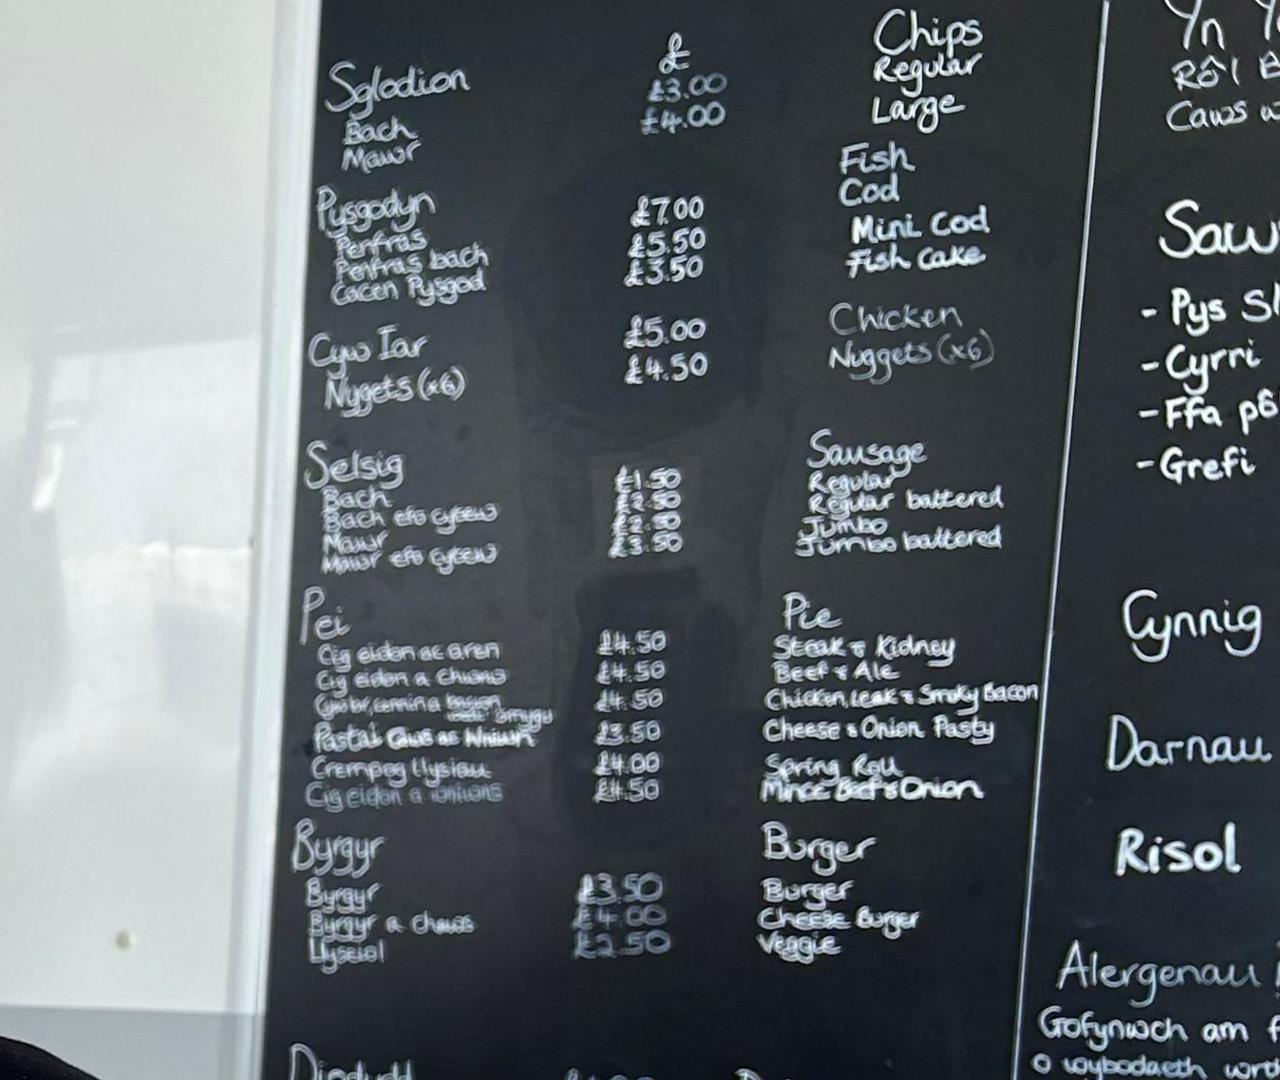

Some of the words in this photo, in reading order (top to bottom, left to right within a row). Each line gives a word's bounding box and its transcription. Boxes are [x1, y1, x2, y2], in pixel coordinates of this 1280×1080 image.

[873, 8, 983, 58] Chips
[659, 32, 690, 74] £
[325, 61, 471, 119] Sglodion
[648, 72, 728, 103] £3.00
[872, 52, 983, 97] Regular
[639, 101, 727, 135] £4.00
[871, 93, 966, 133] Large
[1166, 100, 1248, 132] Caws
[342, 117, 419, 147] Bach
[341, 140, 421, 174] Mawr
[840, 141, 916, 175] Fish
[840, 173, 901, 207] Cod
[315, 186, 436, 240] Pysgodyn
[851, 213, 922, 244] Mini
[929, 205, 991, 236] Cod
[335, 228, 429, 264] Penfras
[428, 241, 489, 271] bach
[627, 227, 707, 260] £5.50
[623, 256, 705, 288] £3.50
[845, 244, 911, 279] Fish
[330, 280, 399, 306] Cacen
[407, 267, 487, 307] Pysgod
[829, 302, 963, 335] Chicken
[1171, 287, 1227, 337] Pys
[623, 315, 707, 349] £5.00
[308, 332, 372, 379] Cyw
[623, 352, 709, 386] £4.50
[828, 339, 933, 385] Nuggets
[1165, 339, 1261, 396] Cyrri
[1164, 396, 1223, 431] Ffa
[304, 440, 403, 490] Selsig
[806, 428, 928, 477] Sausage
[1160, 445, 1256, 485] Grefi
[321, 485, 392, 512] Bach
[808, 469, 896, 497] Regular
[808, 493, 894, 520] Regular
[904, 485, 1005, 510] battered
[322, 509, 386, 533] Bach
[800, 516, 888, 540] Jumbo
[321, 530, 389, 556] Mawr
[794, 535, 898, 558] Jumbo
[901, 524, 1003, 552] battered
[320, 551, 384, 575] Mawr
[299, 586, 351, 646] Pei
[782, 591, 843, 631] Pie
[1122, 588, 1263, 663] Cynnig
[316, 643, 351, 673] Cig
[446, 641, 501, 661] aren
[596, 629, 667, 656] £4.50
[772, 634, 847, 661] Steak
[875, 633, 956, 668] Kidney
[315, 669, 348, 698] Cig
[414, 671, 431, 687] a
[595, 660, 666, 685] £4.50
[771, 660, 829, 685] Beef
[852, 660, 901, 684] Ale
[593, 688, 664, 713] £4.50
[593, 719, 661, 746] £3.50
[762, 718, 841, 742] Cheese
[859, 714, 926, 741] Onion
[931, 713, 996, 746] Pasty
[1105, 713, 1273, 772] Darnau
[311, 754, 408, 788] Crempog
[592, 750, 661, 777] £4.00
[763, 753, 841, 786] Spring
[850, 753, 905, 778] Roll
[305, 780, 344, 813] Cig
[591, 776, 660, 804] £4.50
[898, 776, 985, 801] Onion
[293, 817, 384, 878] Byrgyr
[761, 821, 876, 876] Burger
[1113, 821, 1242, 877] Risol
[304, 877, 382, 914] Byrgyr
[576, 872, 663, 905] £3.50
[760, 877, 854, 911] Burger
[384, 915, 406, 934] a
[572, 904, 667, 929] £4.00
[756, 907, 851, 931] Cheese
[855, 905, 923, 940] Burger
[573, 930, 671, 958] £2.50
[757, 933, 841, 965] Veggie
[1055, 939, 1261, 1008] Alergenau
[1039, 1005, 1188, 1051] Gofynwch
[1202, 1021, 1249, 1043] am
[1031, 1053, 1052, 1075] o
